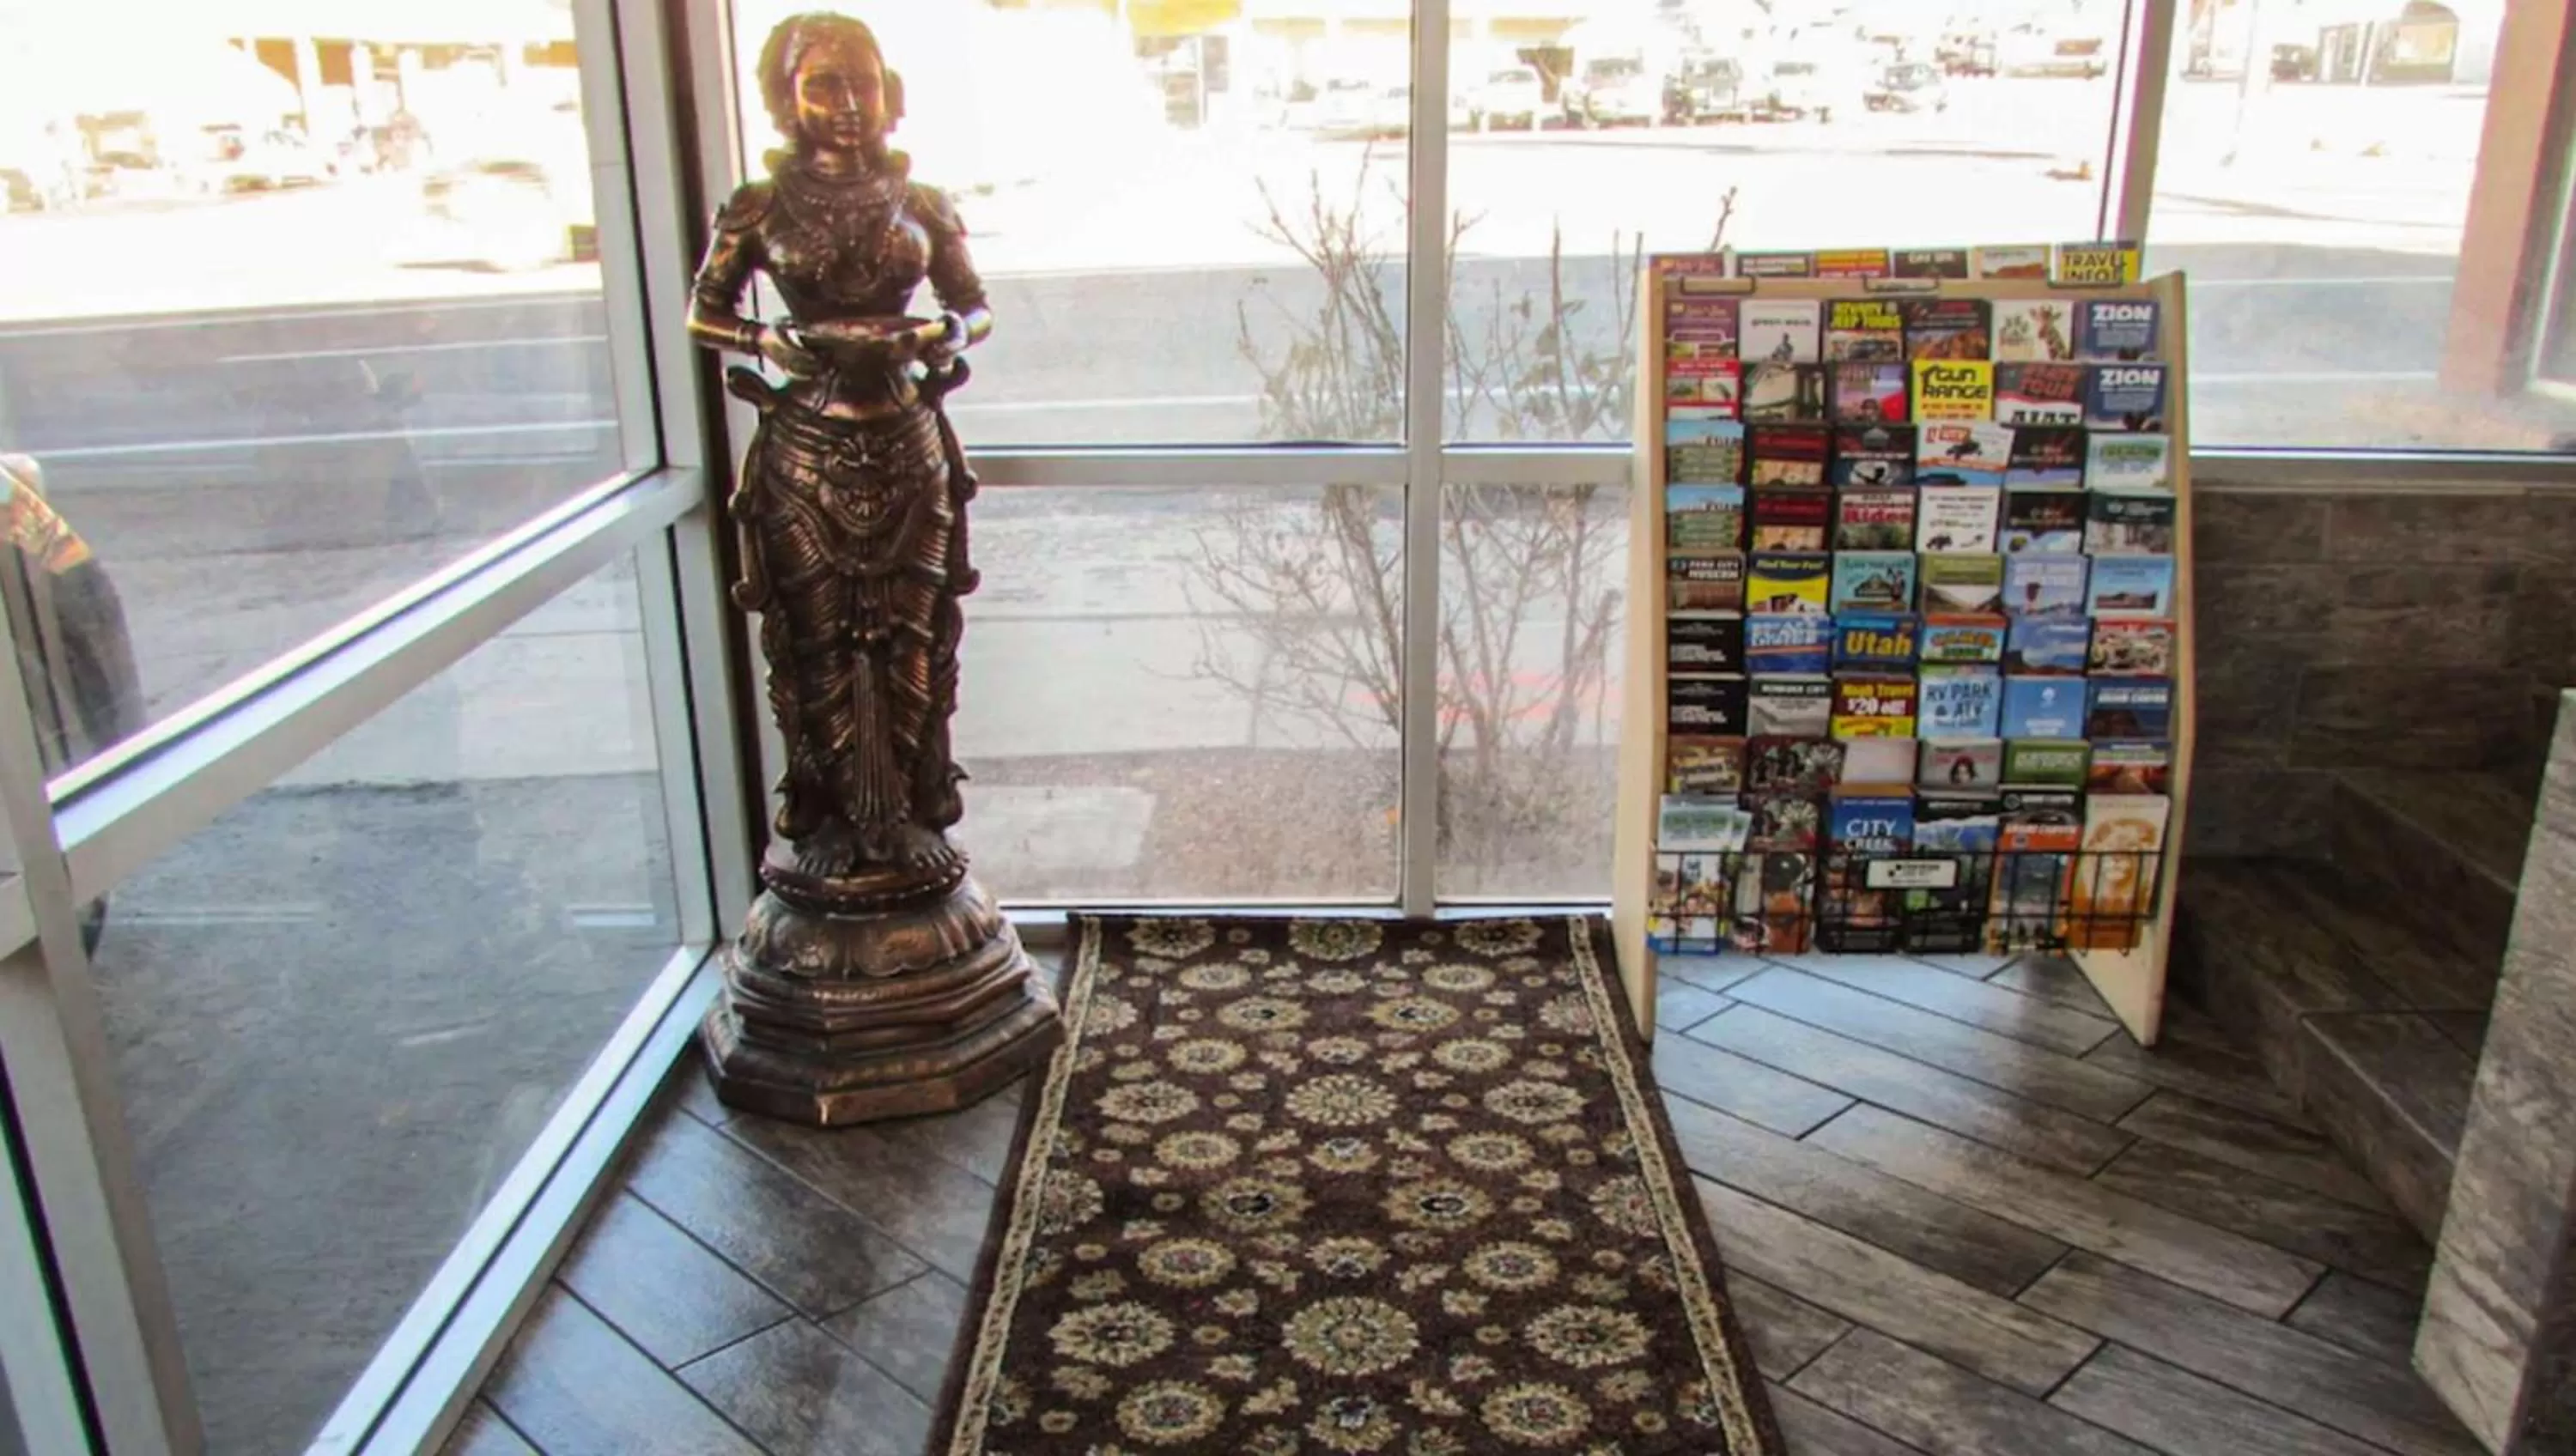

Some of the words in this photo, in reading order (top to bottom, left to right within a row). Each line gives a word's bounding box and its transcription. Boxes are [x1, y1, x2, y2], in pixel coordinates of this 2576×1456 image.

[2093, 305, 2153, 321] ZION
[2099, 368, 2161, 385] ZION
[1846, 630, 1912, 656] Utah
[1846, 818, 1897, 837] CITY
